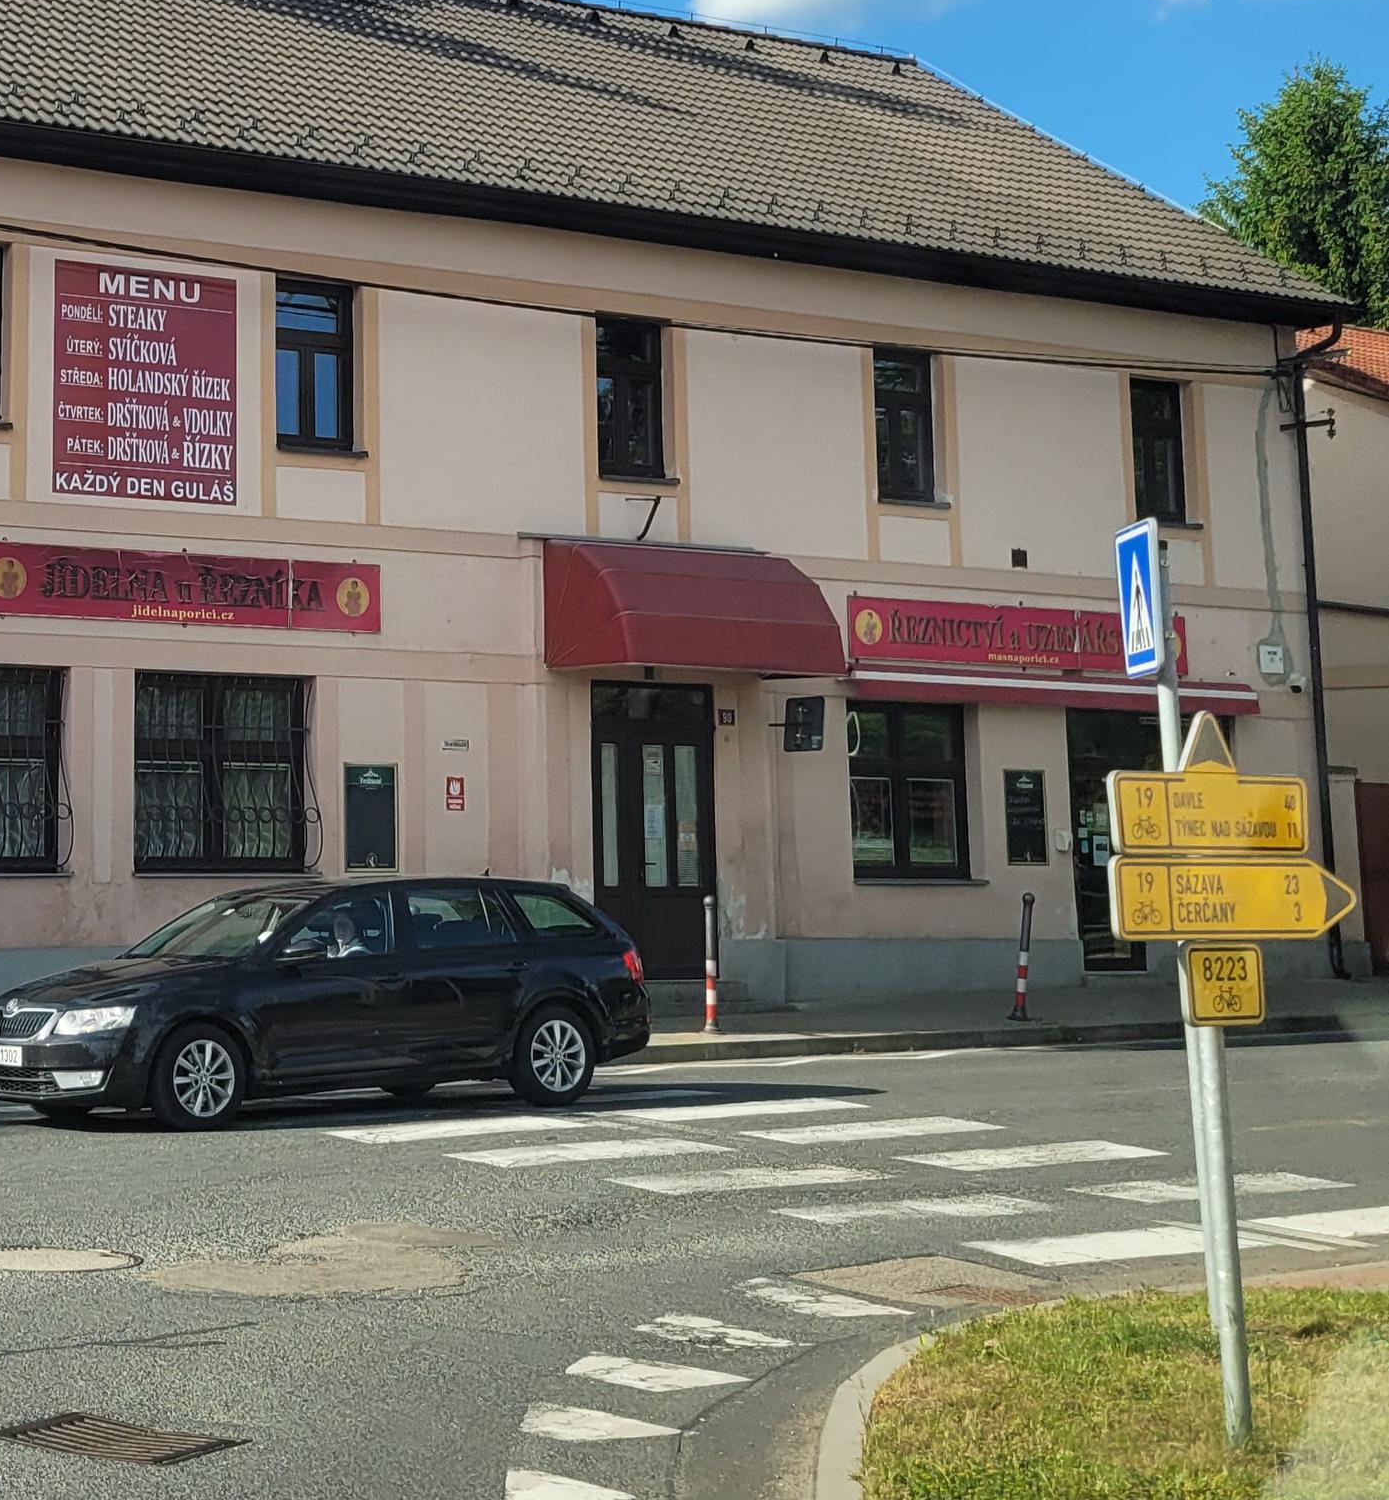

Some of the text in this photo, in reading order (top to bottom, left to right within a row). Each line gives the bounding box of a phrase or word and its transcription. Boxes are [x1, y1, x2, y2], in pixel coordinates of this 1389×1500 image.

[99, 272, 201, 303] MENU
[61, 303, 167, 332] PONDĚLÍ: STEAKY
[66, 333, 177, 367] ÚTERÝ: SVÍČKOVÁ
[60, 367, 231, 401] STŘEDA: HOLANDSKÝ ŘÍZEK
[58, 397, 233, 437] ČTVRTEK: DRŠŤKOVÁ & VDOLKY
[67, 431, 233, 470] PÁTEK: DRŠŤKOVÁ & ŘÍZKY
[55, 470, 234, 502] KAŽDÝ DEN GULÁŠ
[42, 557, 326, 612] JÍDELNA u ŘEZNÍKA
[131, 604, 234, 621] jidelnaporici.cz
[889, 607, 1123, 655] ŘEZNICTVÍ a UZENÁŘS
[988, 653, 1059, 664] masnaporici.cz
[1135, 787, 1153, 809] 19
[1173, 792, 1204, 810] DAVLE
[1175, 815, 1299, 839] TÝNEC NAD SÁZAVOU 11
[1137, 872, 1155, 894] 19
[1176, 869, 1300, 895] SÁZAVA 23
[1178, 897, 1302, 923] ČERČANY 3
[1202, 956, 1248, 982] 8223
